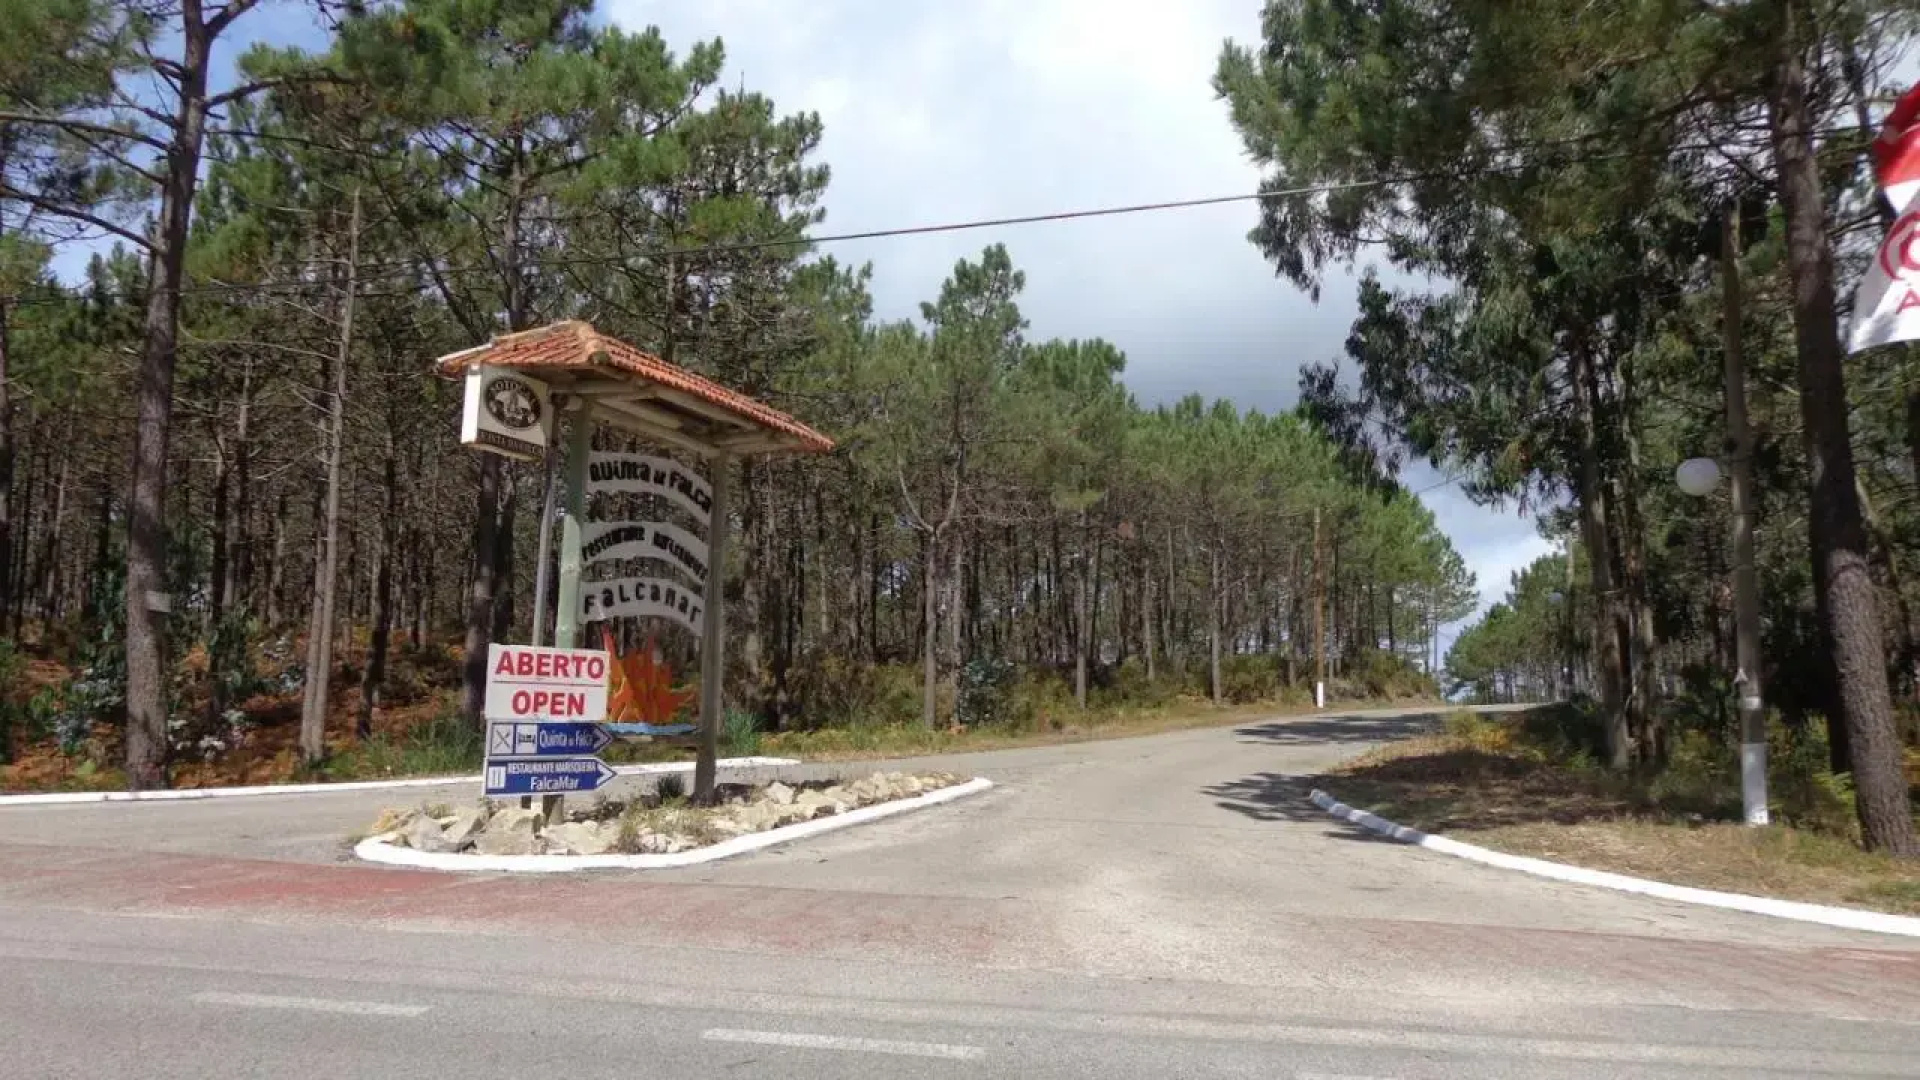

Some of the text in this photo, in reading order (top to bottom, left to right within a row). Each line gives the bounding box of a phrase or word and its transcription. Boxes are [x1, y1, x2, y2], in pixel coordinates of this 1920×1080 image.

[495, 650, 604, 679] ABERTO
[512, 689, 586, 717] OPEN
[530, 775, 580, 791] FalcaMar
